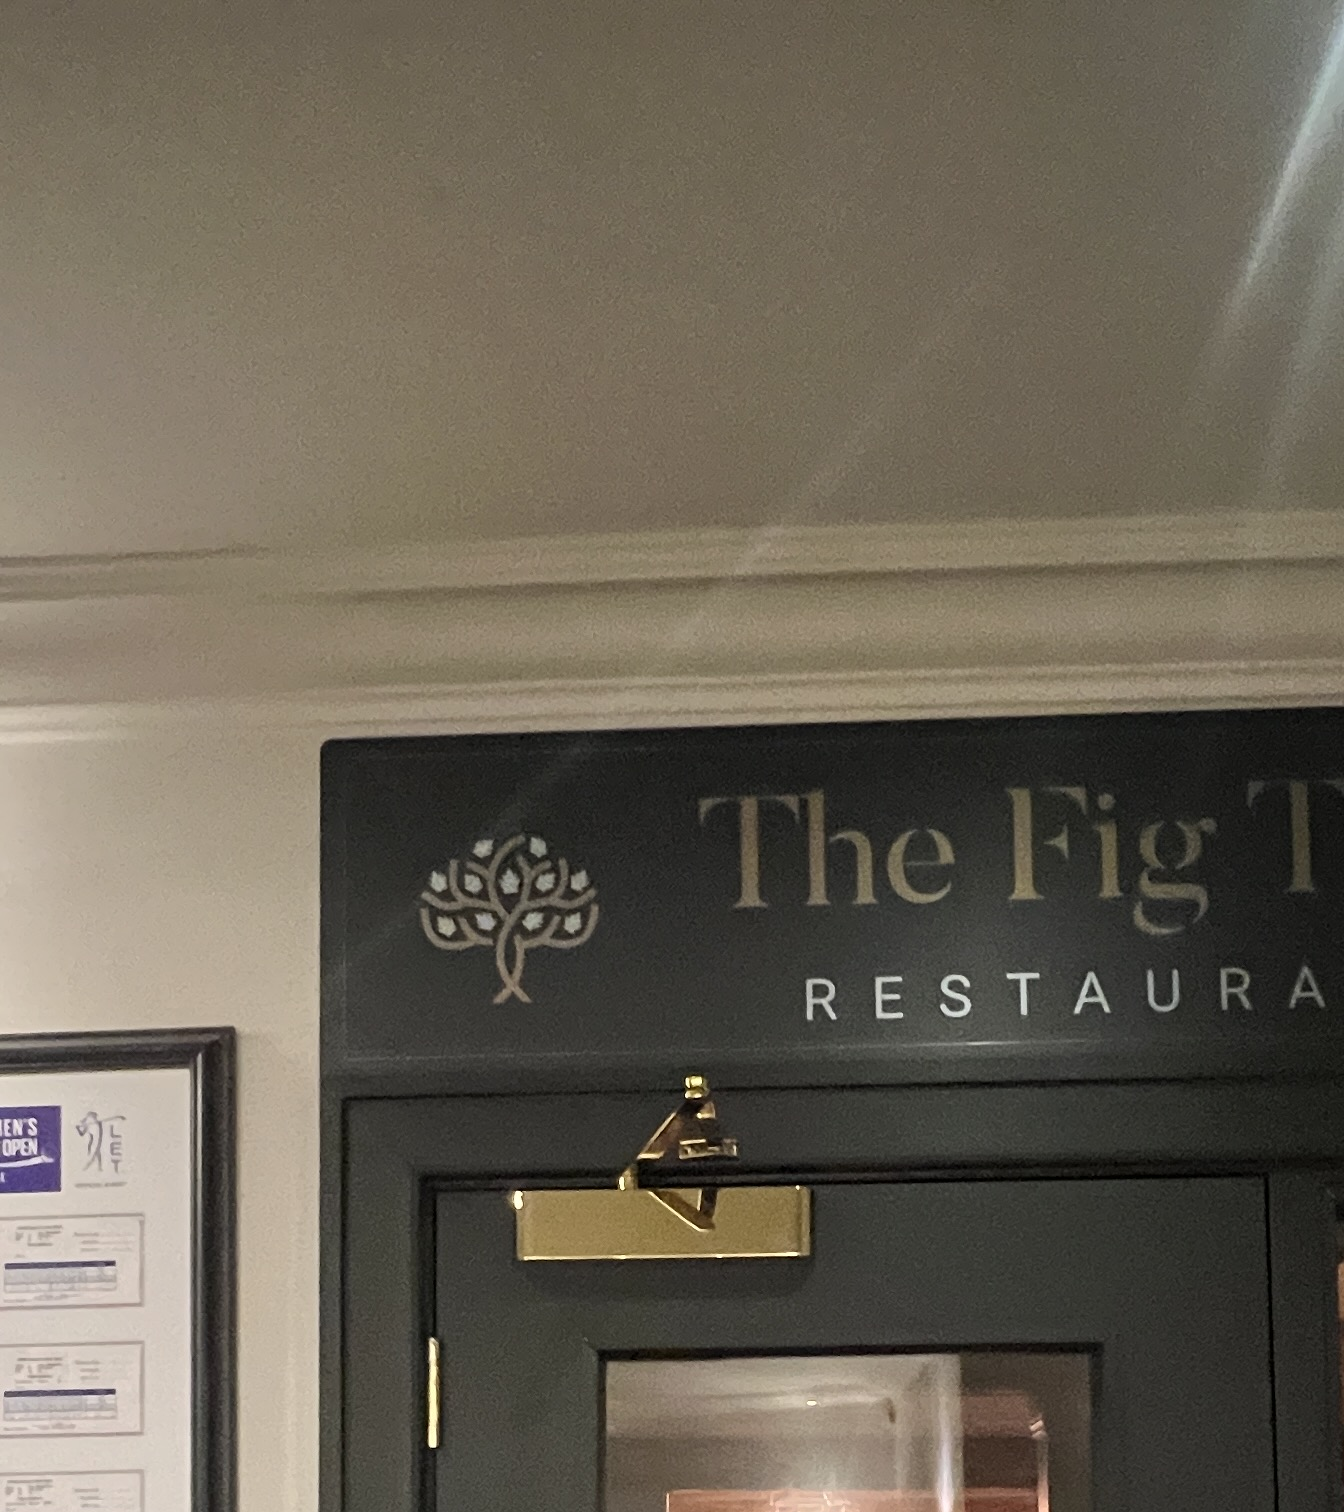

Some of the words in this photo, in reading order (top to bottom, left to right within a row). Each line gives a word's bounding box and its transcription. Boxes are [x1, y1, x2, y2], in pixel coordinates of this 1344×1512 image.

[697, 788, 957, 909] The
[1003, 786, 1218, 937] Fig
[2, 1137, 39, 1156] OPEN
